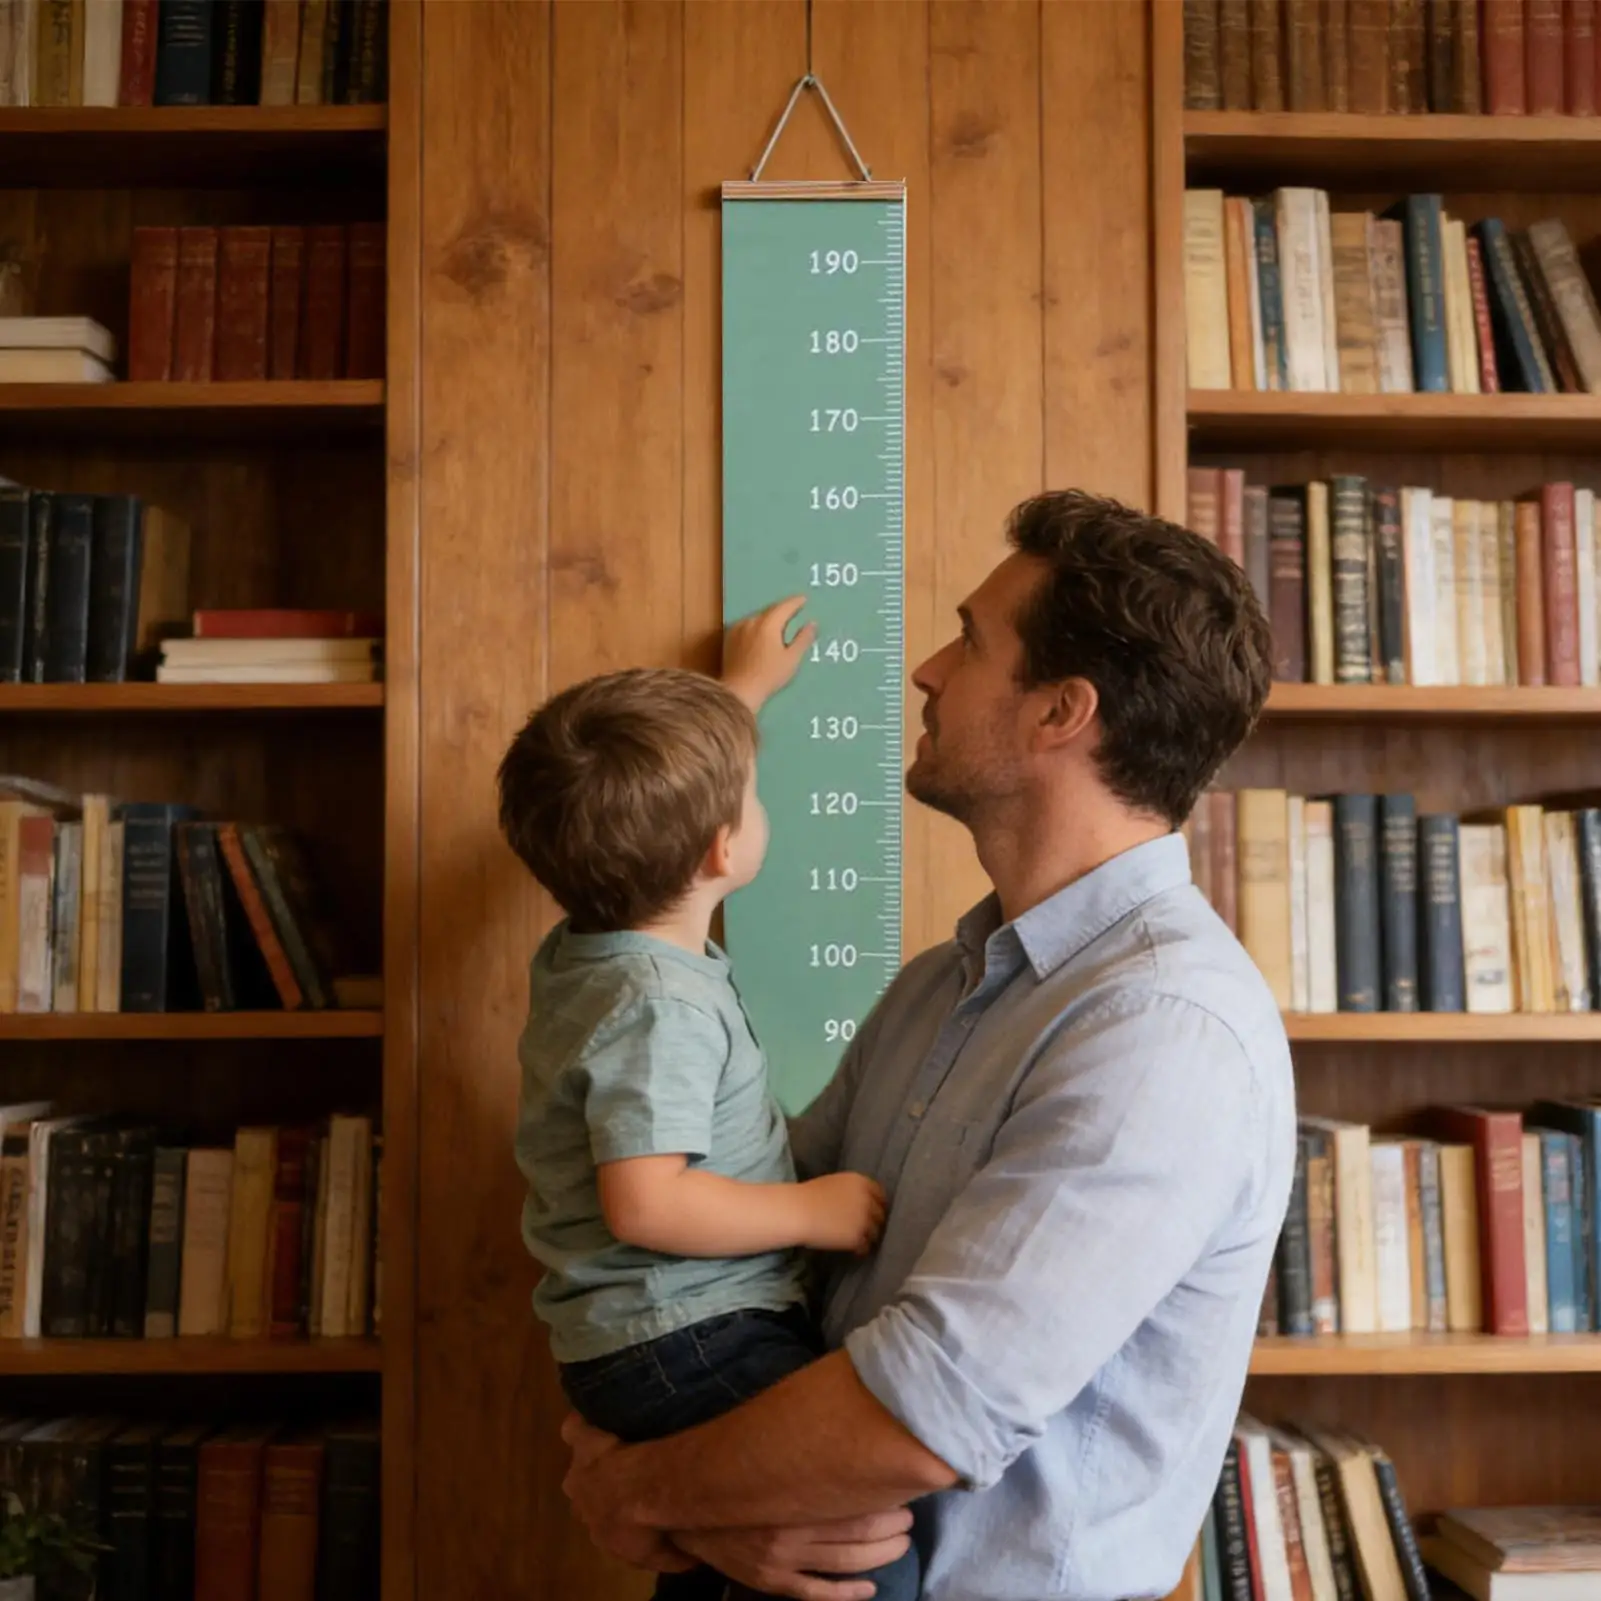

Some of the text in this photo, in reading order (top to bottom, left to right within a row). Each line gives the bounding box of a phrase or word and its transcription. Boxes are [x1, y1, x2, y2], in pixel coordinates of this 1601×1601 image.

[809, 250, 858, 274] 190
[809, 330, 858, 354] 180
[809, 408, 858, 432] 170
[809, 486, 858, 510] 160
[809, 562, 858, 586] 150
[810, 639, 858, 662] 140
[809, 716, 858, 739] 130
[809, 792, 858, 815] 120
[809, 868, 858, 891] 110
[809, 945, 857, 967] 100
[824, 1019, 857, 1042] 90
